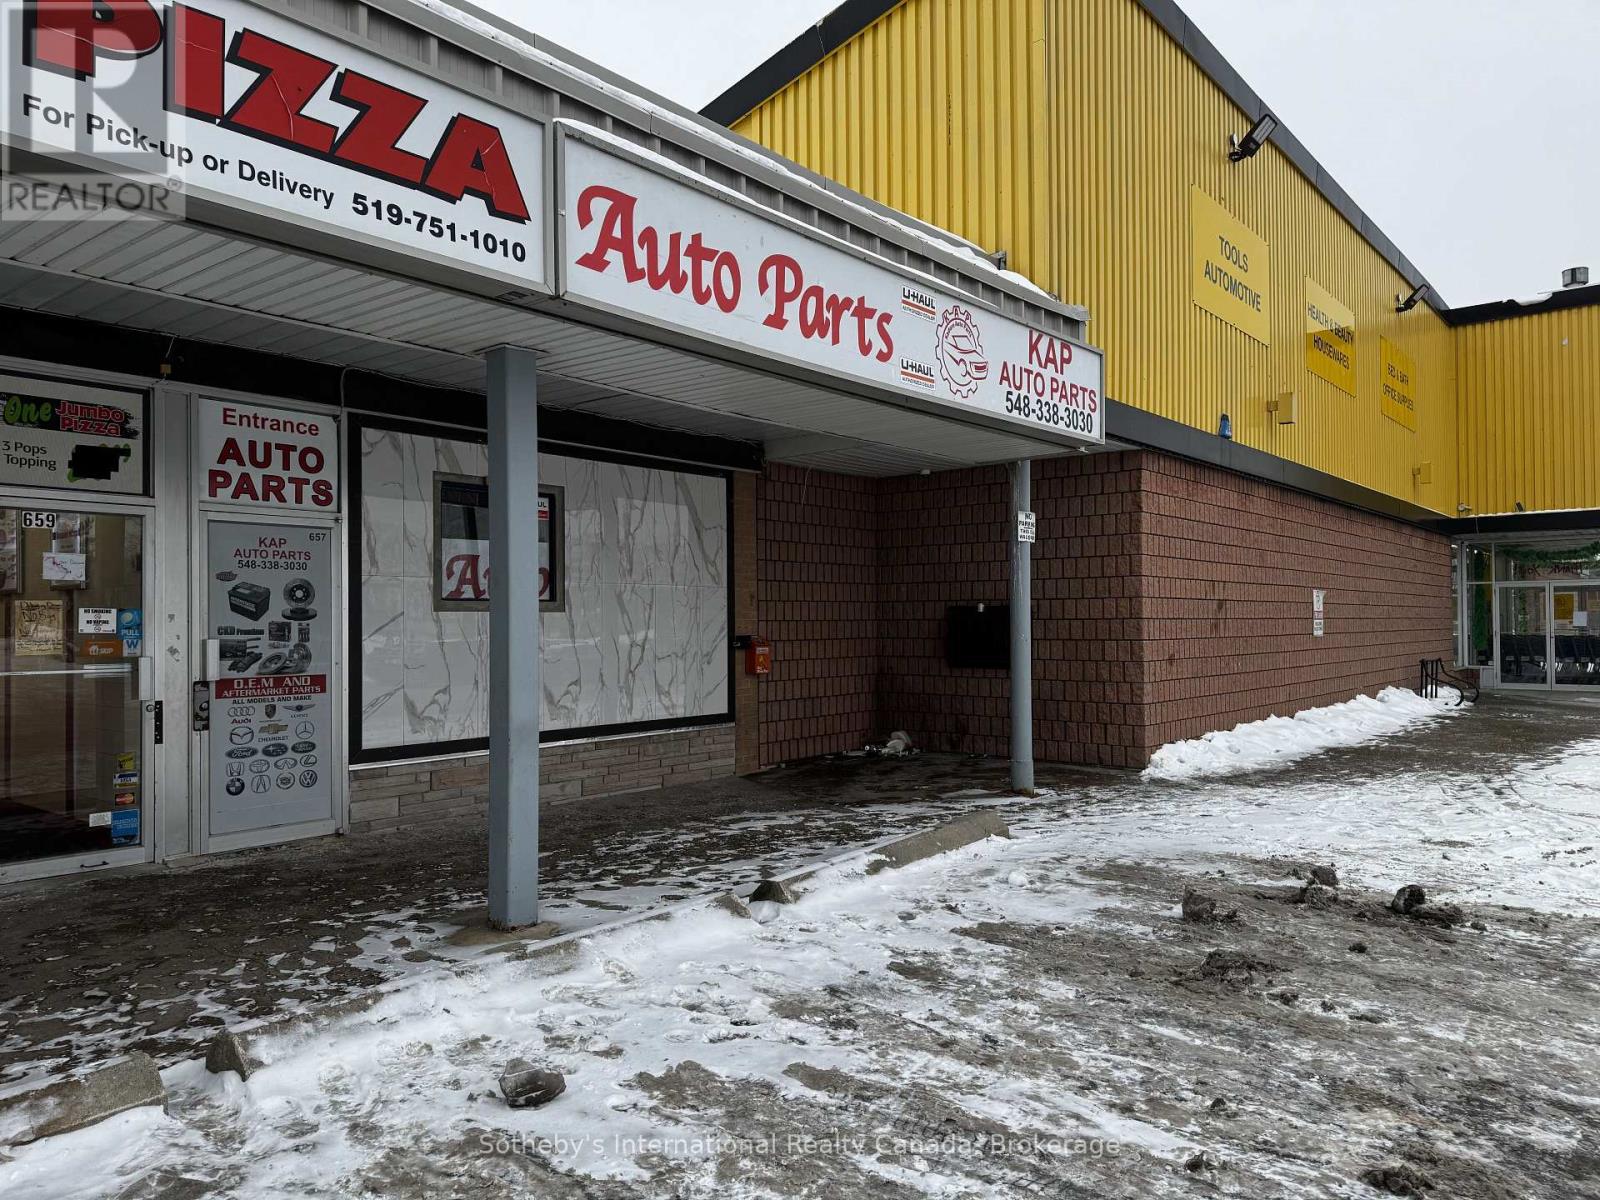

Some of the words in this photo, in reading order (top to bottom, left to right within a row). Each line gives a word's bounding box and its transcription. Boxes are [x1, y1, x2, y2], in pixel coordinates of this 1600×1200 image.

[22, 0, 531, 224] PIZZA
[23, 94, 75, 129] For
[86, 113, 193, 166] Pick-up
[202, 153, 229, 175] or
[238, 160, 335, 209] Delivery
[352, 193, 526, 263] 519-751-1010
[1218, 236, 1249, 273] TOOLS
[575, 185, 742, 314] Auto
[758, 254, 894, 363] Parts
[1204, 260, 1262, 313] AUTOMOTIVE
[902, 287, 936, 310] U-HAUL
[1307, 302, 1328, 328] HEALTH
[1334, 321, 1354, 346] BEAUTY
[1028, 330, 1073, 375] KAP
[1313, 333, 1350, 370] HOUSEWARES
[901, 359, 935, 377] U-HAUL
[999, 361, 1046, 398] AUTO
[1050, 376, 1097, 413] PARTS
[4, 396, 52, 425] One
[55, 401, 125, 422] Jumbo
[222, 407, 320, 436] Entrance
[1005, 391, 1093, 433] 548-338-3030
[60, 416, 121, 436] Pizza
[2, 441, 11, 451] 3
[14, 442, 48, 457] Pops
[3, 453, 57, 472] Topping
[216, 437, 325, 474] AUTO
[208, 469, 334, 507] PARTS
[23, 512, 56, 528] 659
[258, 537, 287, 548] KAP
[309, 533, 327, 542] 657
[233, 549, 269, 559] AUTO
[272, 550, 312, 561] PARTS
[237, 560, 308, 571] 548-338-3030
[222, 687, 290, 698] AFTERMARKET
[293, 685, 321, 694] PARTS
[233, 677, 274, 690] O.E.M
[282, 676, 311, 686] AND
